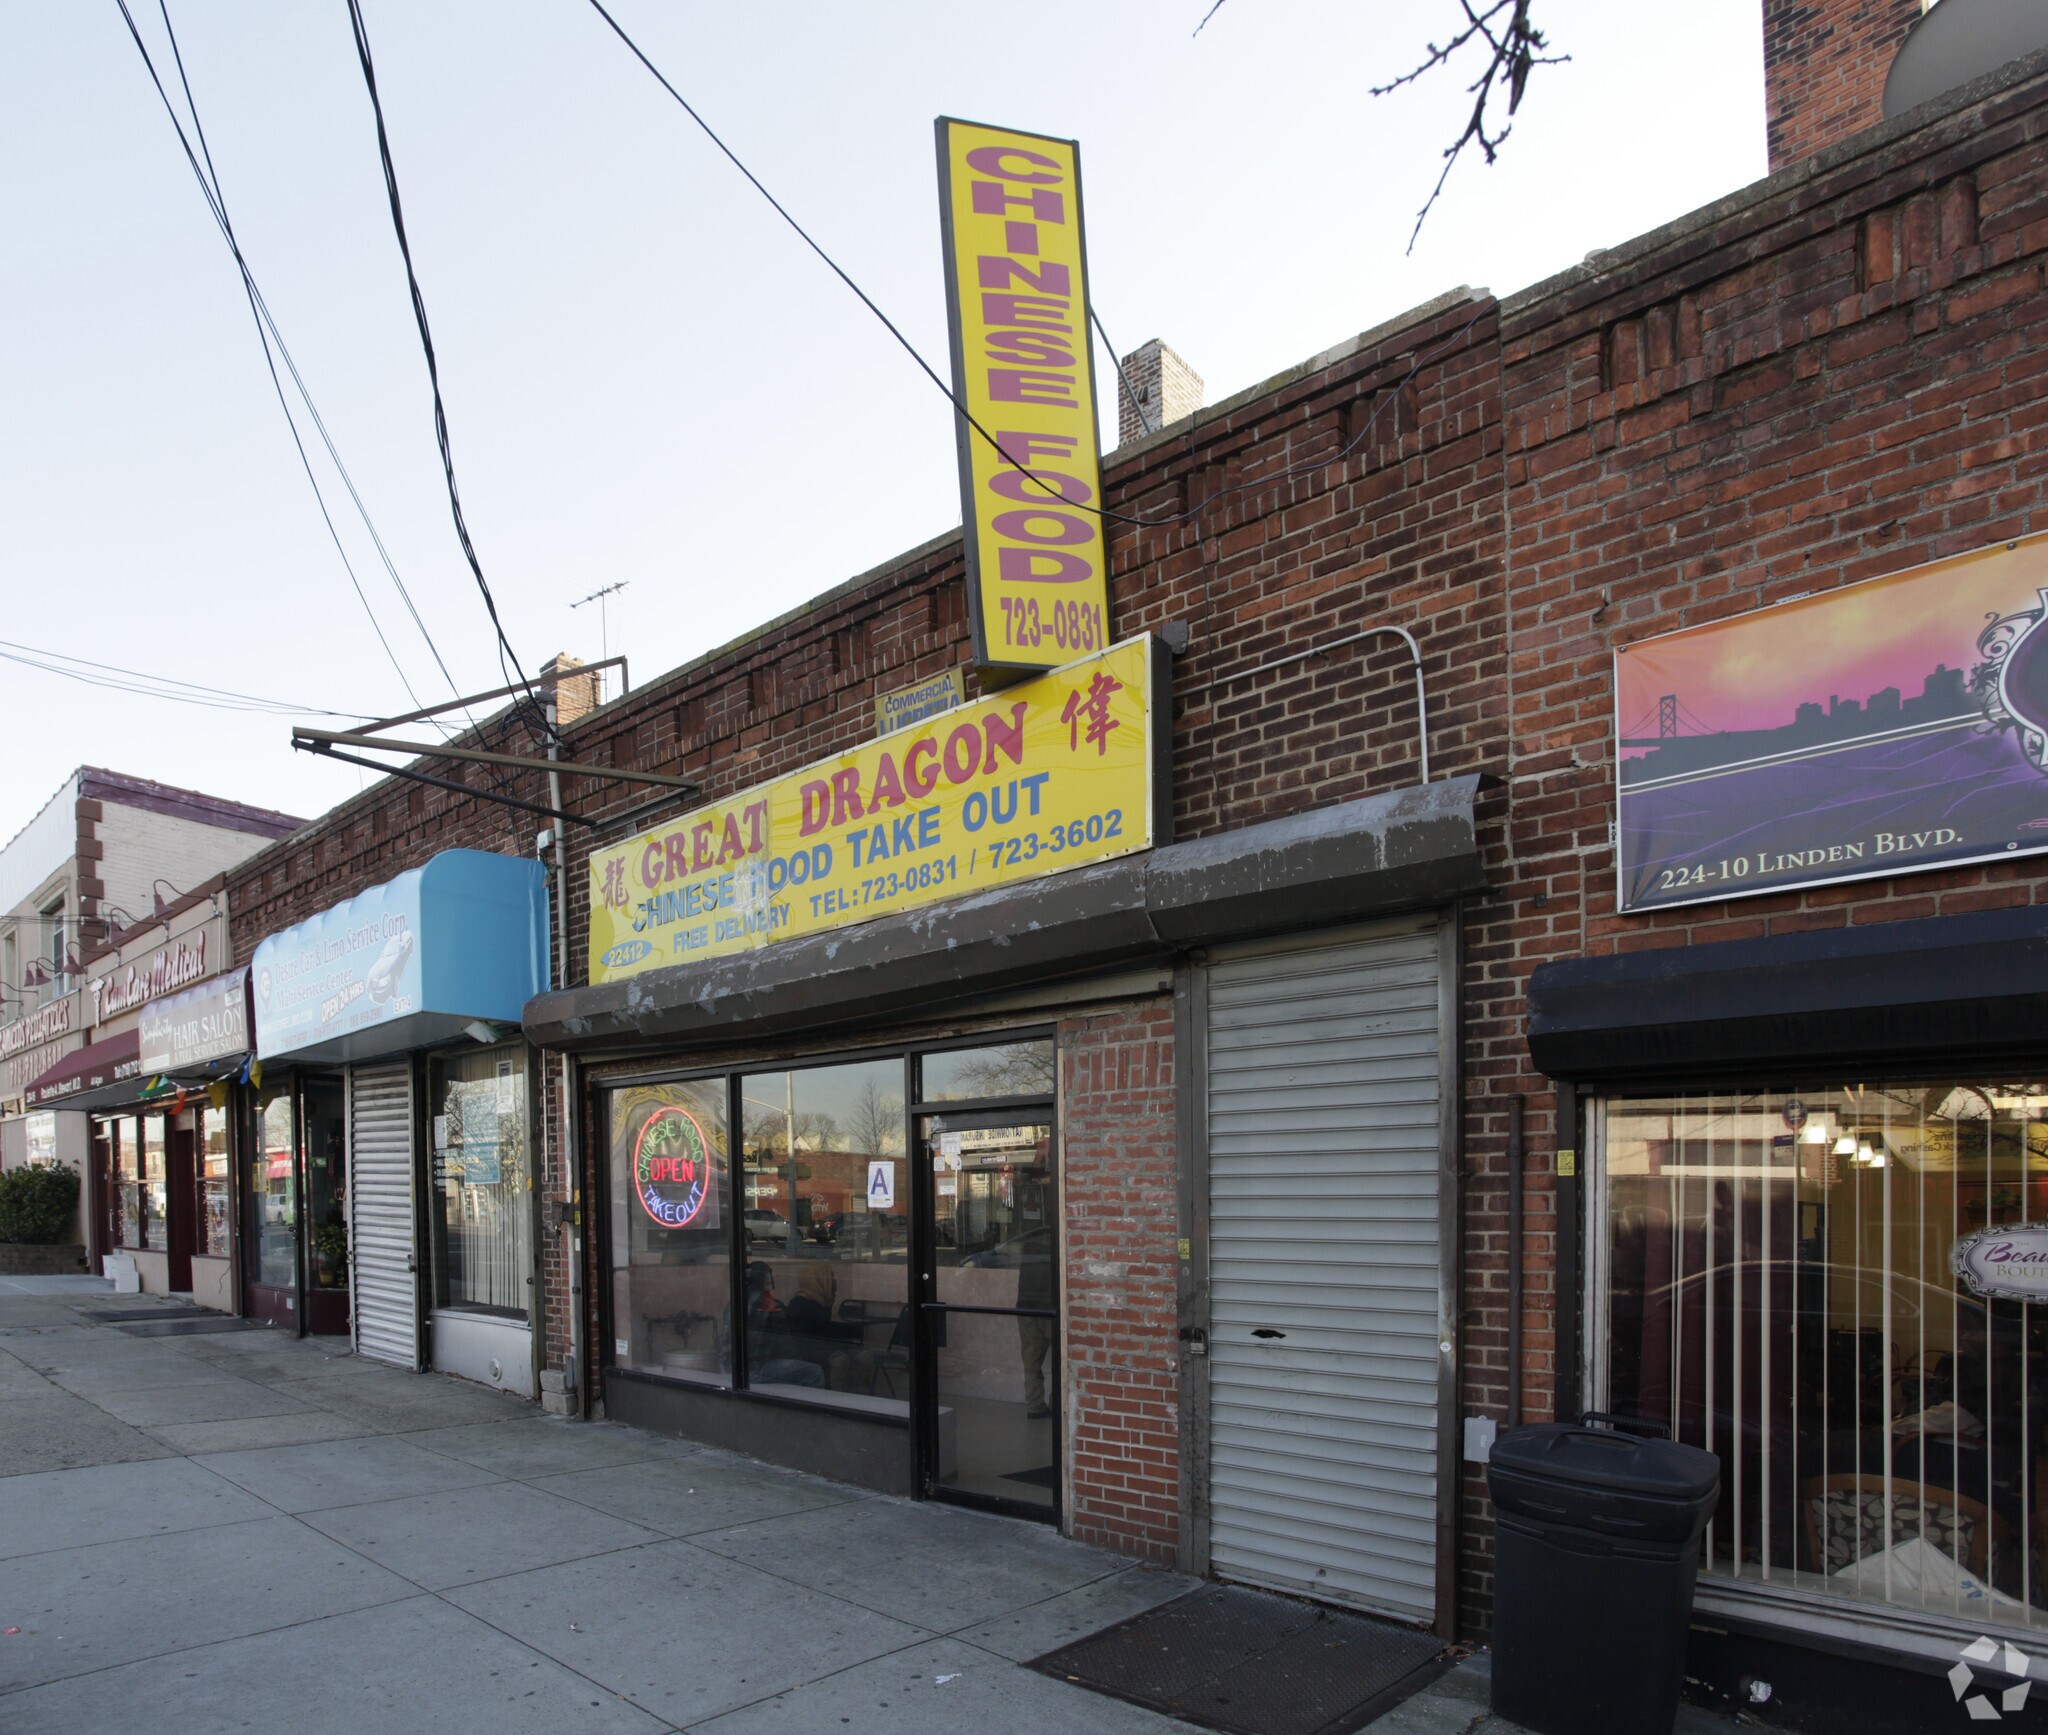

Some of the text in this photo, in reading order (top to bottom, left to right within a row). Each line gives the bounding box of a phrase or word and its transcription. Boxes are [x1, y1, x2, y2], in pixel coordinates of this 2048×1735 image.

[965, 146, 1079, 409] CHINESE
[988, 430, 1096, 584] FOOD
[1000, 596, 1103, 652] 723-0831
[885, 675, 955, 714] COMMERCIAL
[641, 702, 1028, 889] GREAT DRAGON
[846, 805, 941, 869] TAKE
[962, 771, 1050, 833] OUT
[988, 808, 1122, 869] 723-3602
[1660, 857, 1749, 889] 224-10
[300, 950, 313, 974] Car
[315, 944, 323, 967] &
[323, 937, 344, 963] Limo
[347, 919, 379, 953] Service
[673, 903, 790, 954] FREE DELIVERY
[152, 930, 205, 996] Medical
[297, 979, 324, 1000] Service
[327, 969, 353, 990] Center
[173, 1020, 199, 1050] HAIR
[202, 1005, 242, 1042] SALON
[321, 980, 365, 1023] OPEN 24 HRS
[194, 1040, 219, 1060] SERVICE
[220, 1034, 243, 1053] SALON
[638, 1117, 703, 1182] CHINESE FOOD
[649, 1157, 695, 1182] OPEN
[870, 1167, 889, 1195] A
